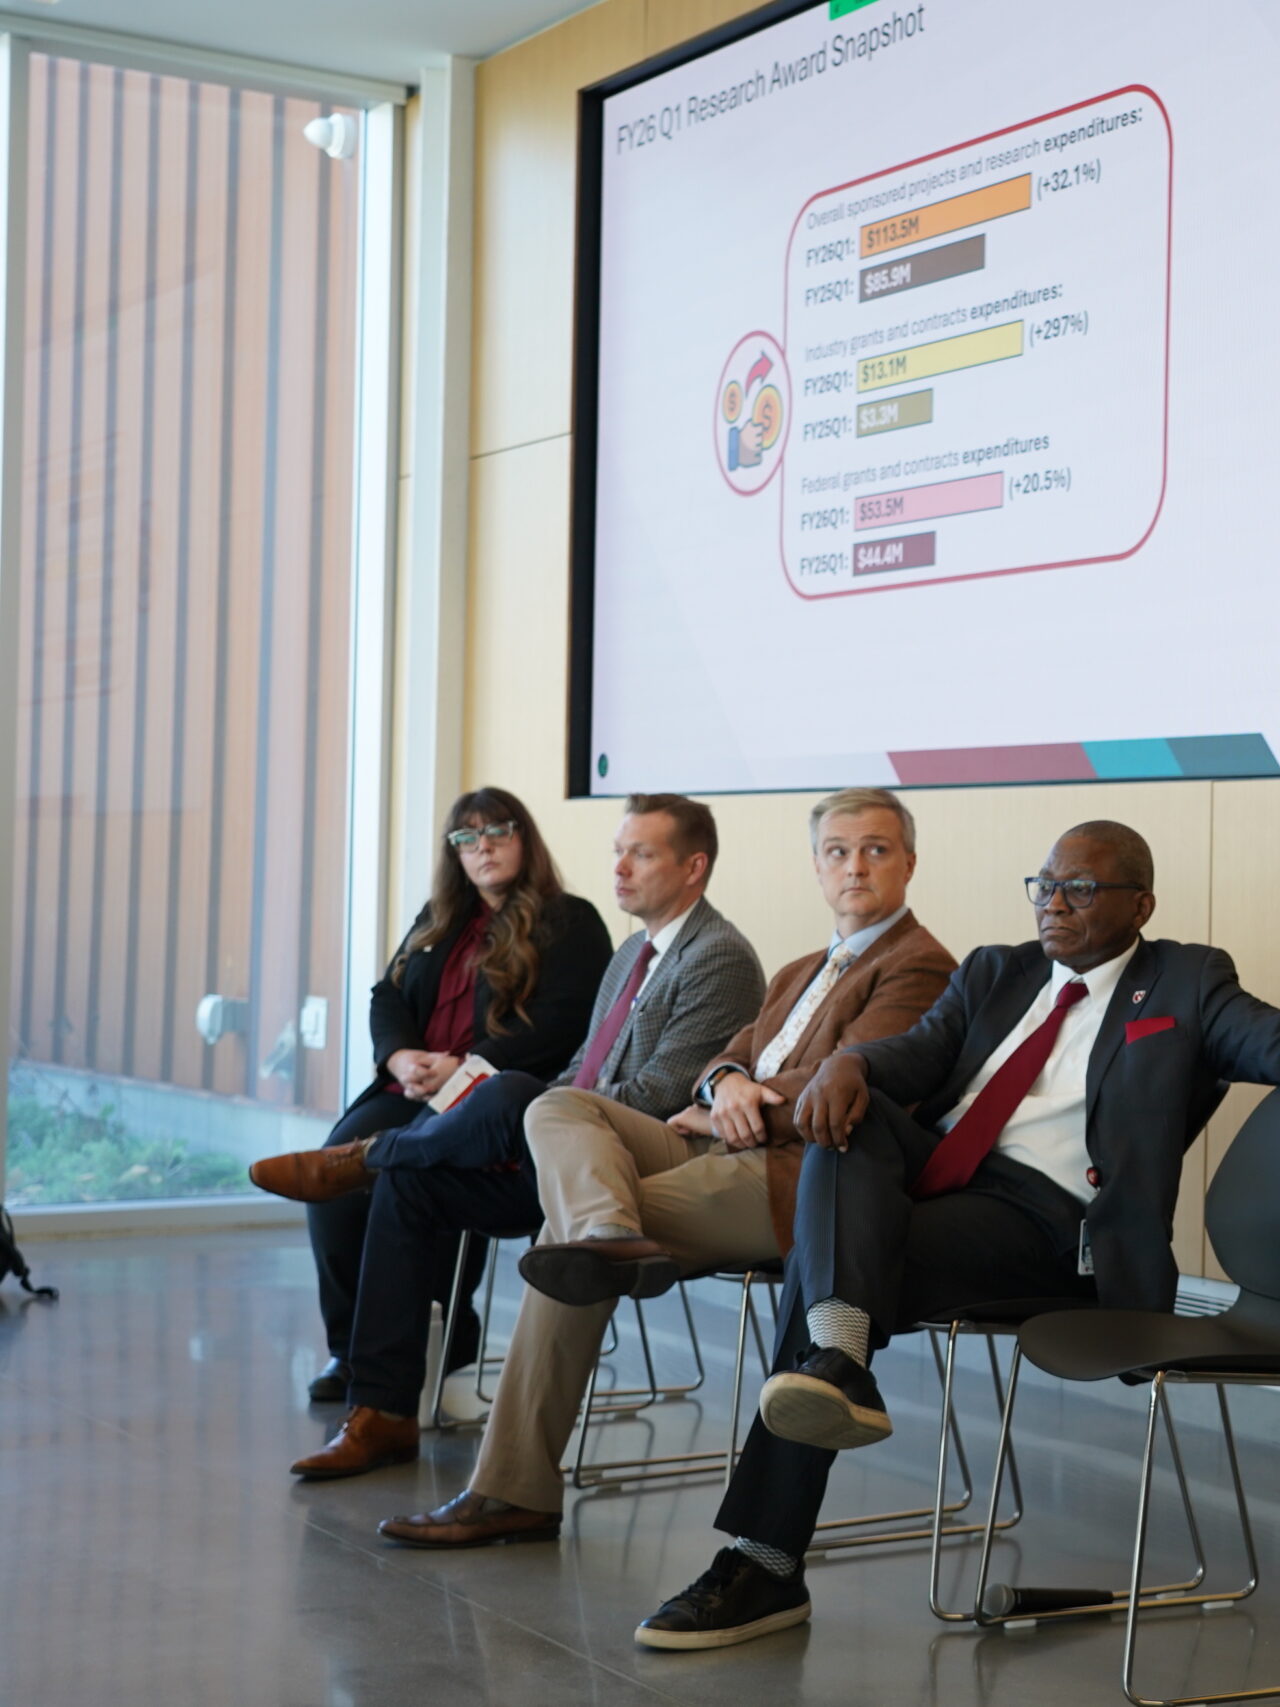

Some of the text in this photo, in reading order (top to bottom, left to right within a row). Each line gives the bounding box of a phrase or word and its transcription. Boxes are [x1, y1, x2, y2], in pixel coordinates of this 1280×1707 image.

[617, 3, 925, 155] FY26 Q1 Research Award Snapshot
[806, 107, 1144, 230] Overall sponsored projects and research expenditures:
[805, 158, 1101, 268] FY26Q1: $113.5M (+32.1%)
[804, 262, 911, 307] FY25Q1: $85.9M
[804, 311, 1089, 397] FY26Q1: $13.1M (+297%)
[805, 283, 1064, 362] Industry grants and contracts expenditures:
[803, 413, 853, 441] FY25Q1:
[801, 434, 1050, 495] Federal grants and contracts expenditures
[801, 467, 1072, 532] FY26Q1: $53.5M (+20.5%)
[800, 541, 904, 576] FY25Q1: $44.4M
